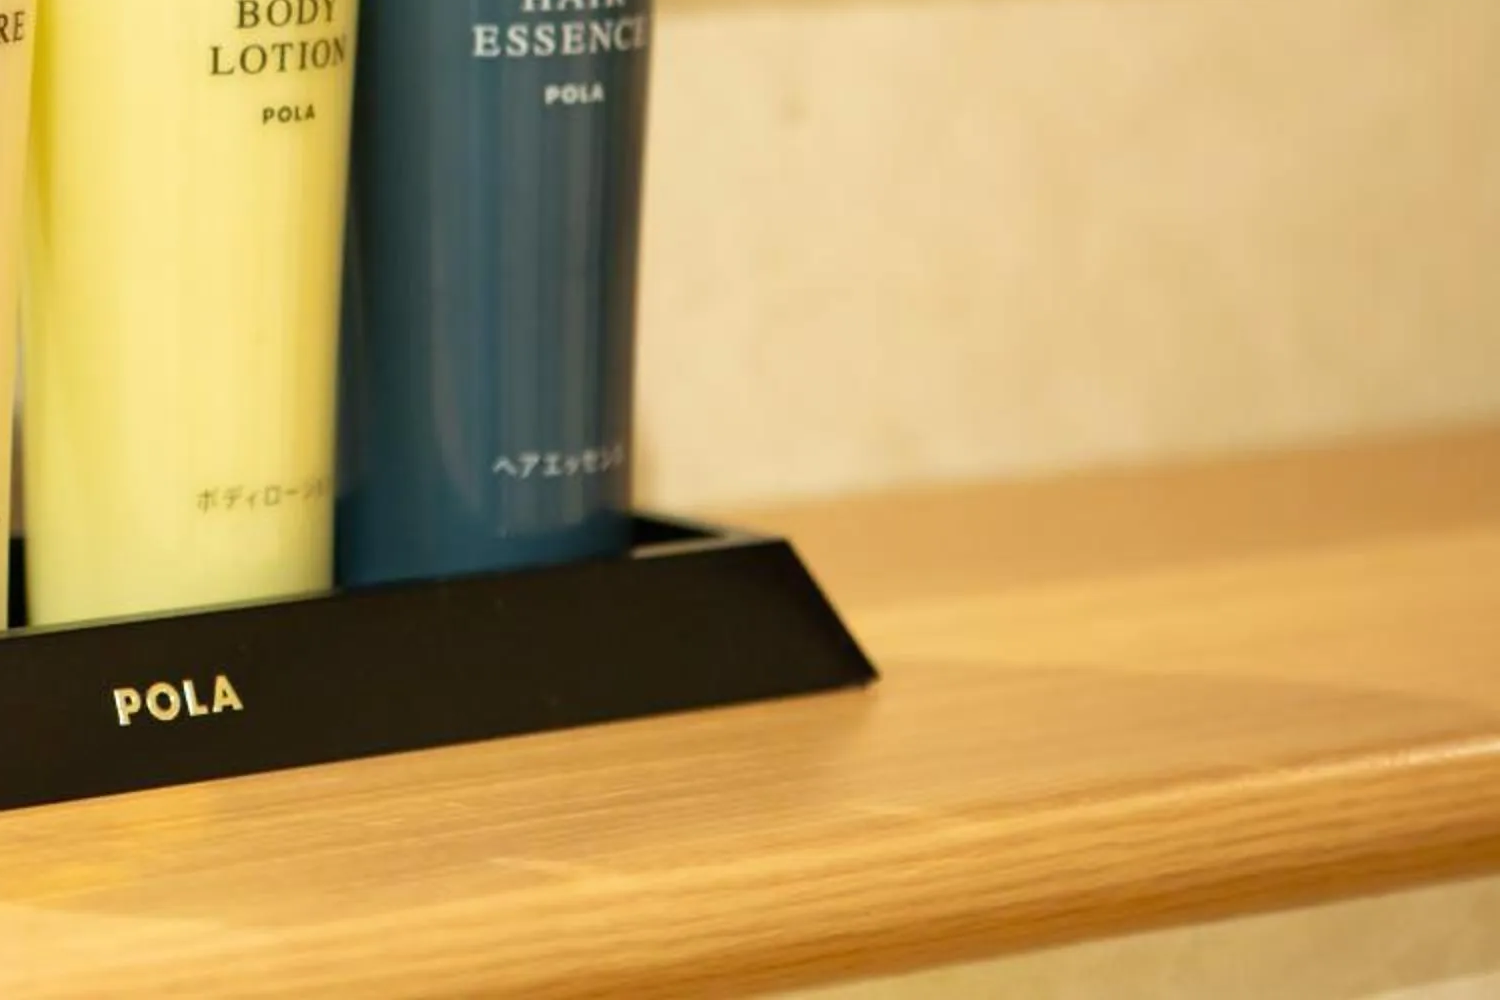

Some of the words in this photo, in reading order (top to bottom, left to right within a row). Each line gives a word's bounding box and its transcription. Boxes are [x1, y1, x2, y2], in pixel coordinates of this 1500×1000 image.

[209, 34, 347, 76] LOTION
[544, 82, 605, 105] POLA
[262, 103, 316, 125] POLA
[113, 673, 245, 727] POLA
